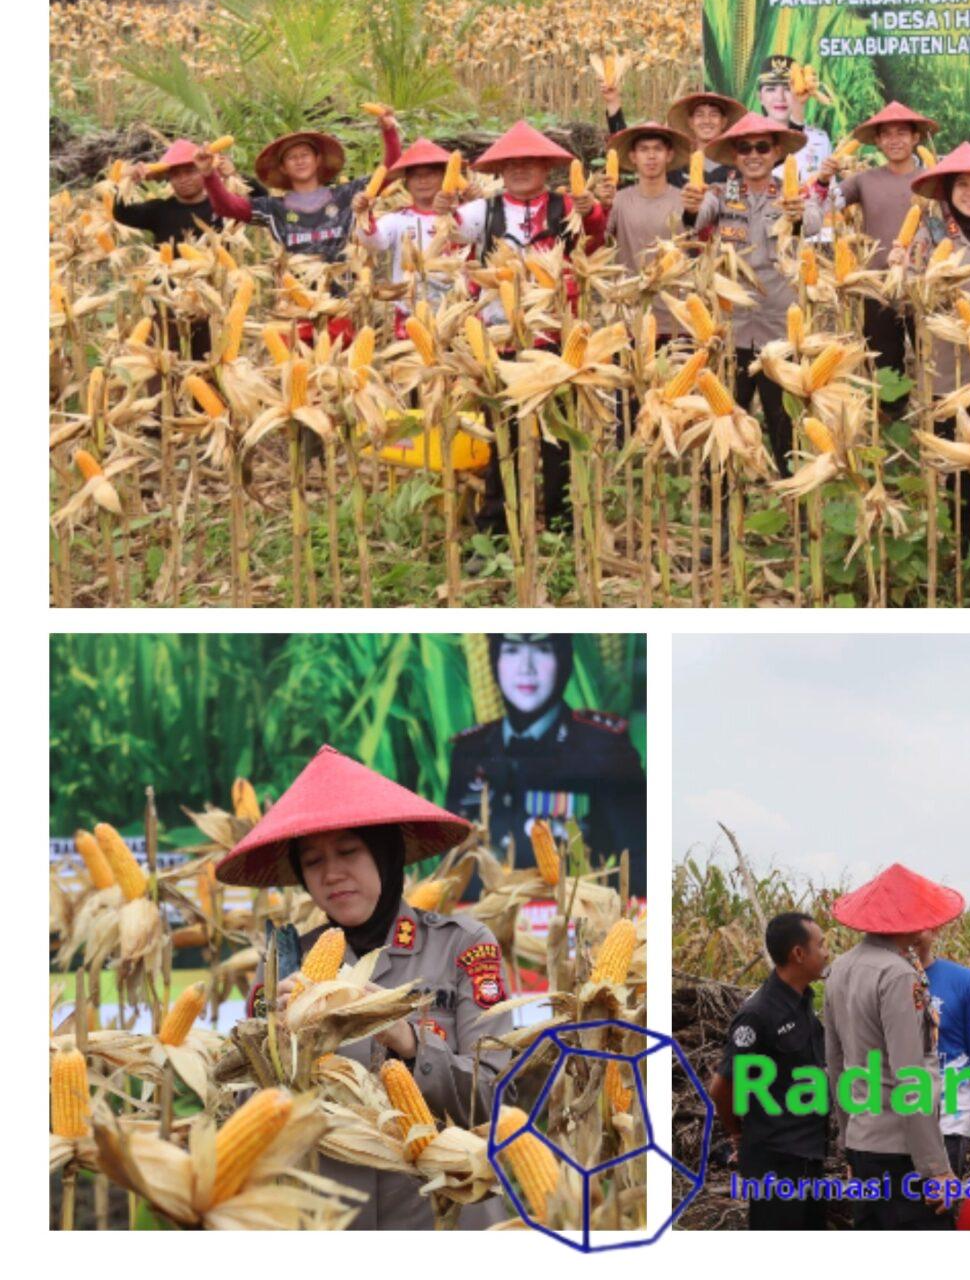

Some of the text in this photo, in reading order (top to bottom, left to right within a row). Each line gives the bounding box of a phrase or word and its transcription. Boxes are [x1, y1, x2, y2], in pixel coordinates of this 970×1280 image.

[870, 11, 879, 30] 1
[883, 10, 939, 30] DESA
[943, 10, 951, 29] 1
[819, 35, 943, 57] SEKABUPATEN
